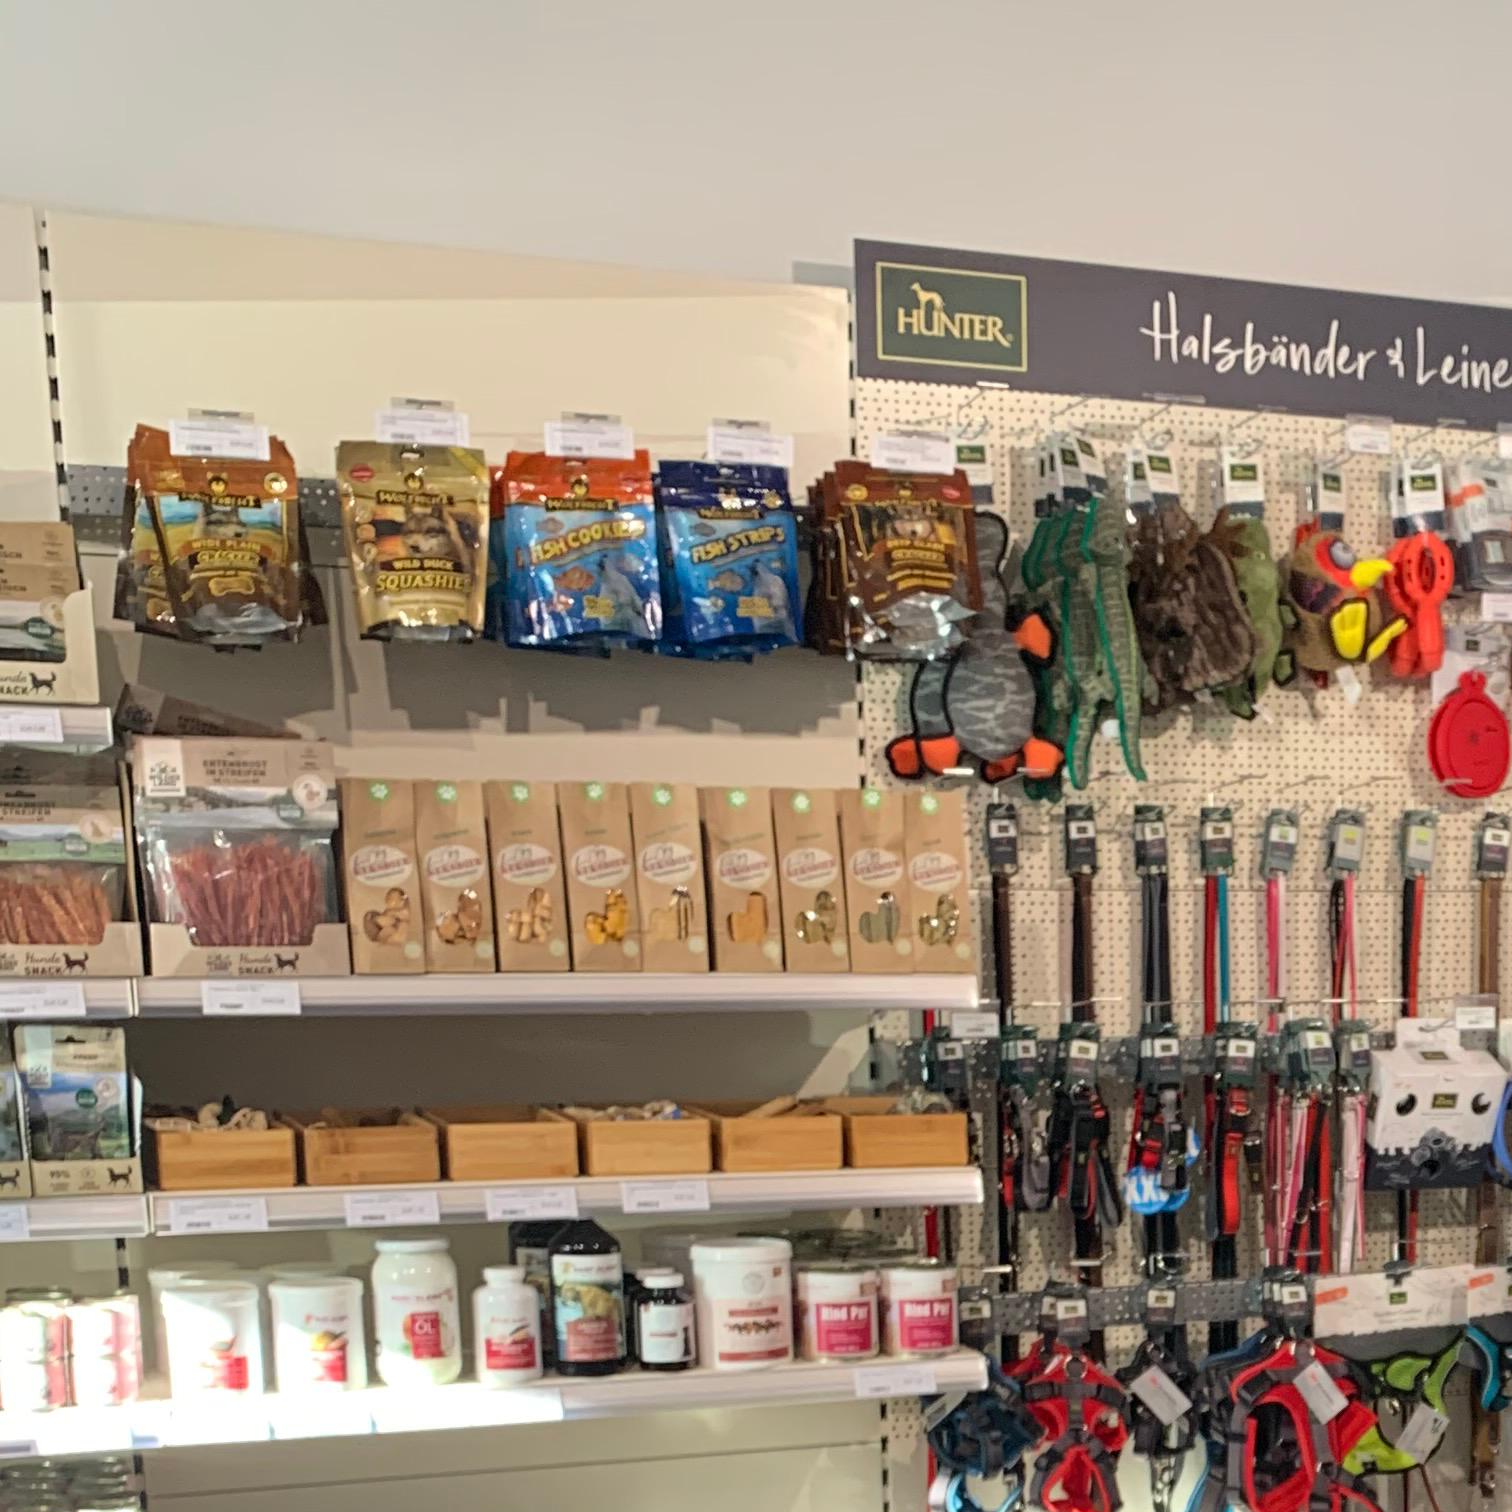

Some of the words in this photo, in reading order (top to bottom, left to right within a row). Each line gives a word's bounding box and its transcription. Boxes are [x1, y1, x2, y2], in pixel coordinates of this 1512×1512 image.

[897, 302, 1011, 348] HUNTER
[1140, 291, 1377, 381] Halsbänder
[692, 537, 727, 562] FISH
[729, 527, 785, 551] STRIPS
[393, 559, 424, 571] WILD
